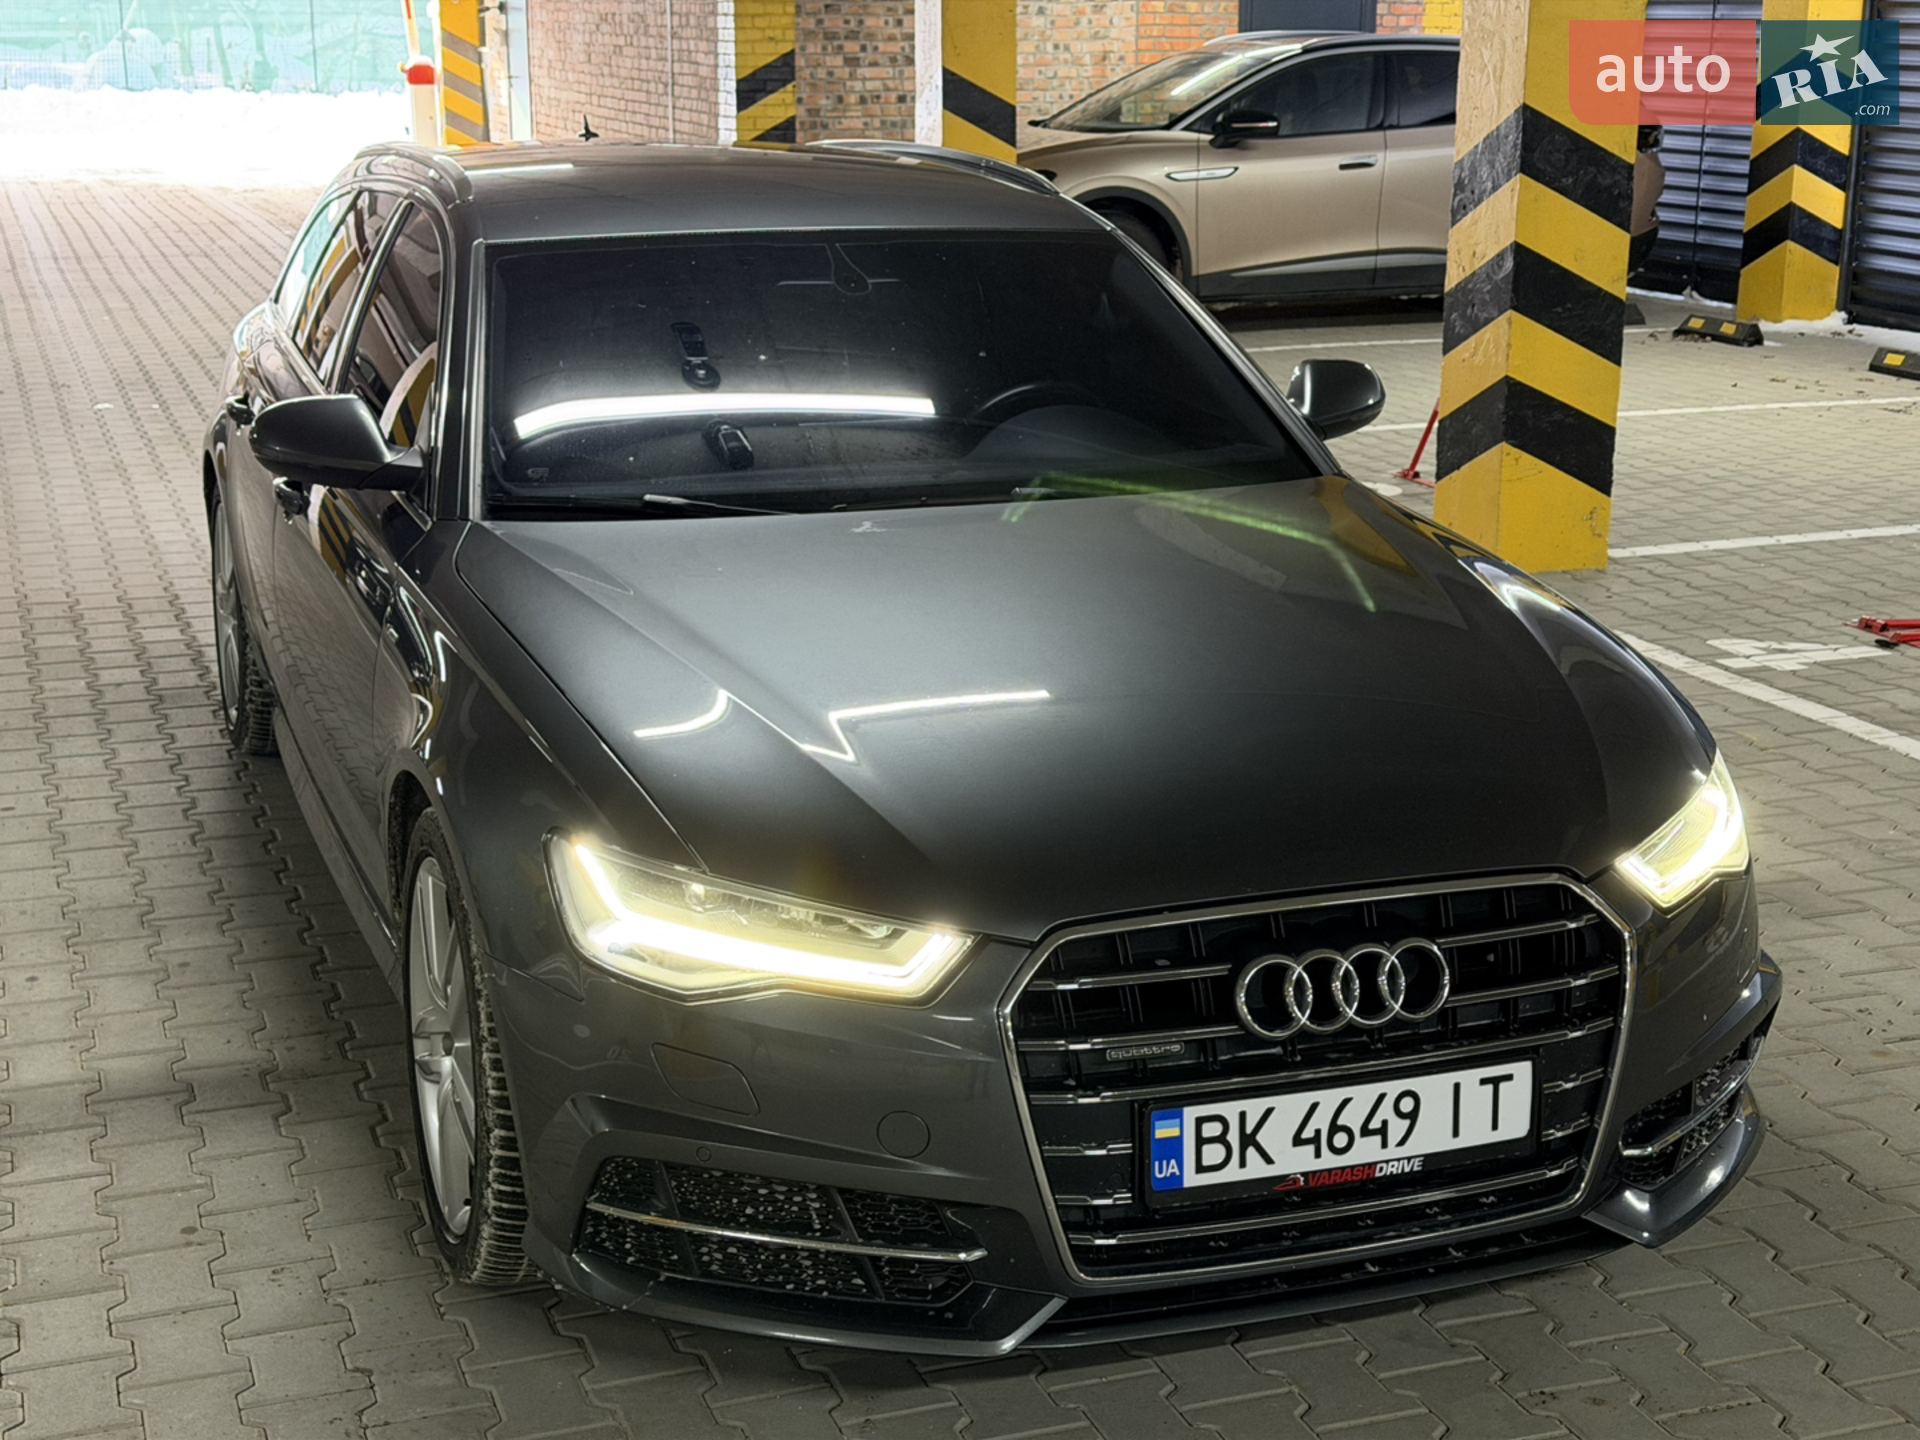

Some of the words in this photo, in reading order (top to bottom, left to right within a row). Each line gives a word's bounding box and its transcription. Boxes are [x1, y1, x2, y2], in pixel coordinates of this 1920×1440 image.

[1110, 1044, 1181, 1059] quattro
[1194, 1106, 1276, 1175] BK
[1292, 1089, 1421, 1160] 4649
[1452, 1073, 1515, 1138] IT
[1154, 1158, 1180, 1179] UA
[1308, 1157, 1424, 1188] VARASHDRIVE
